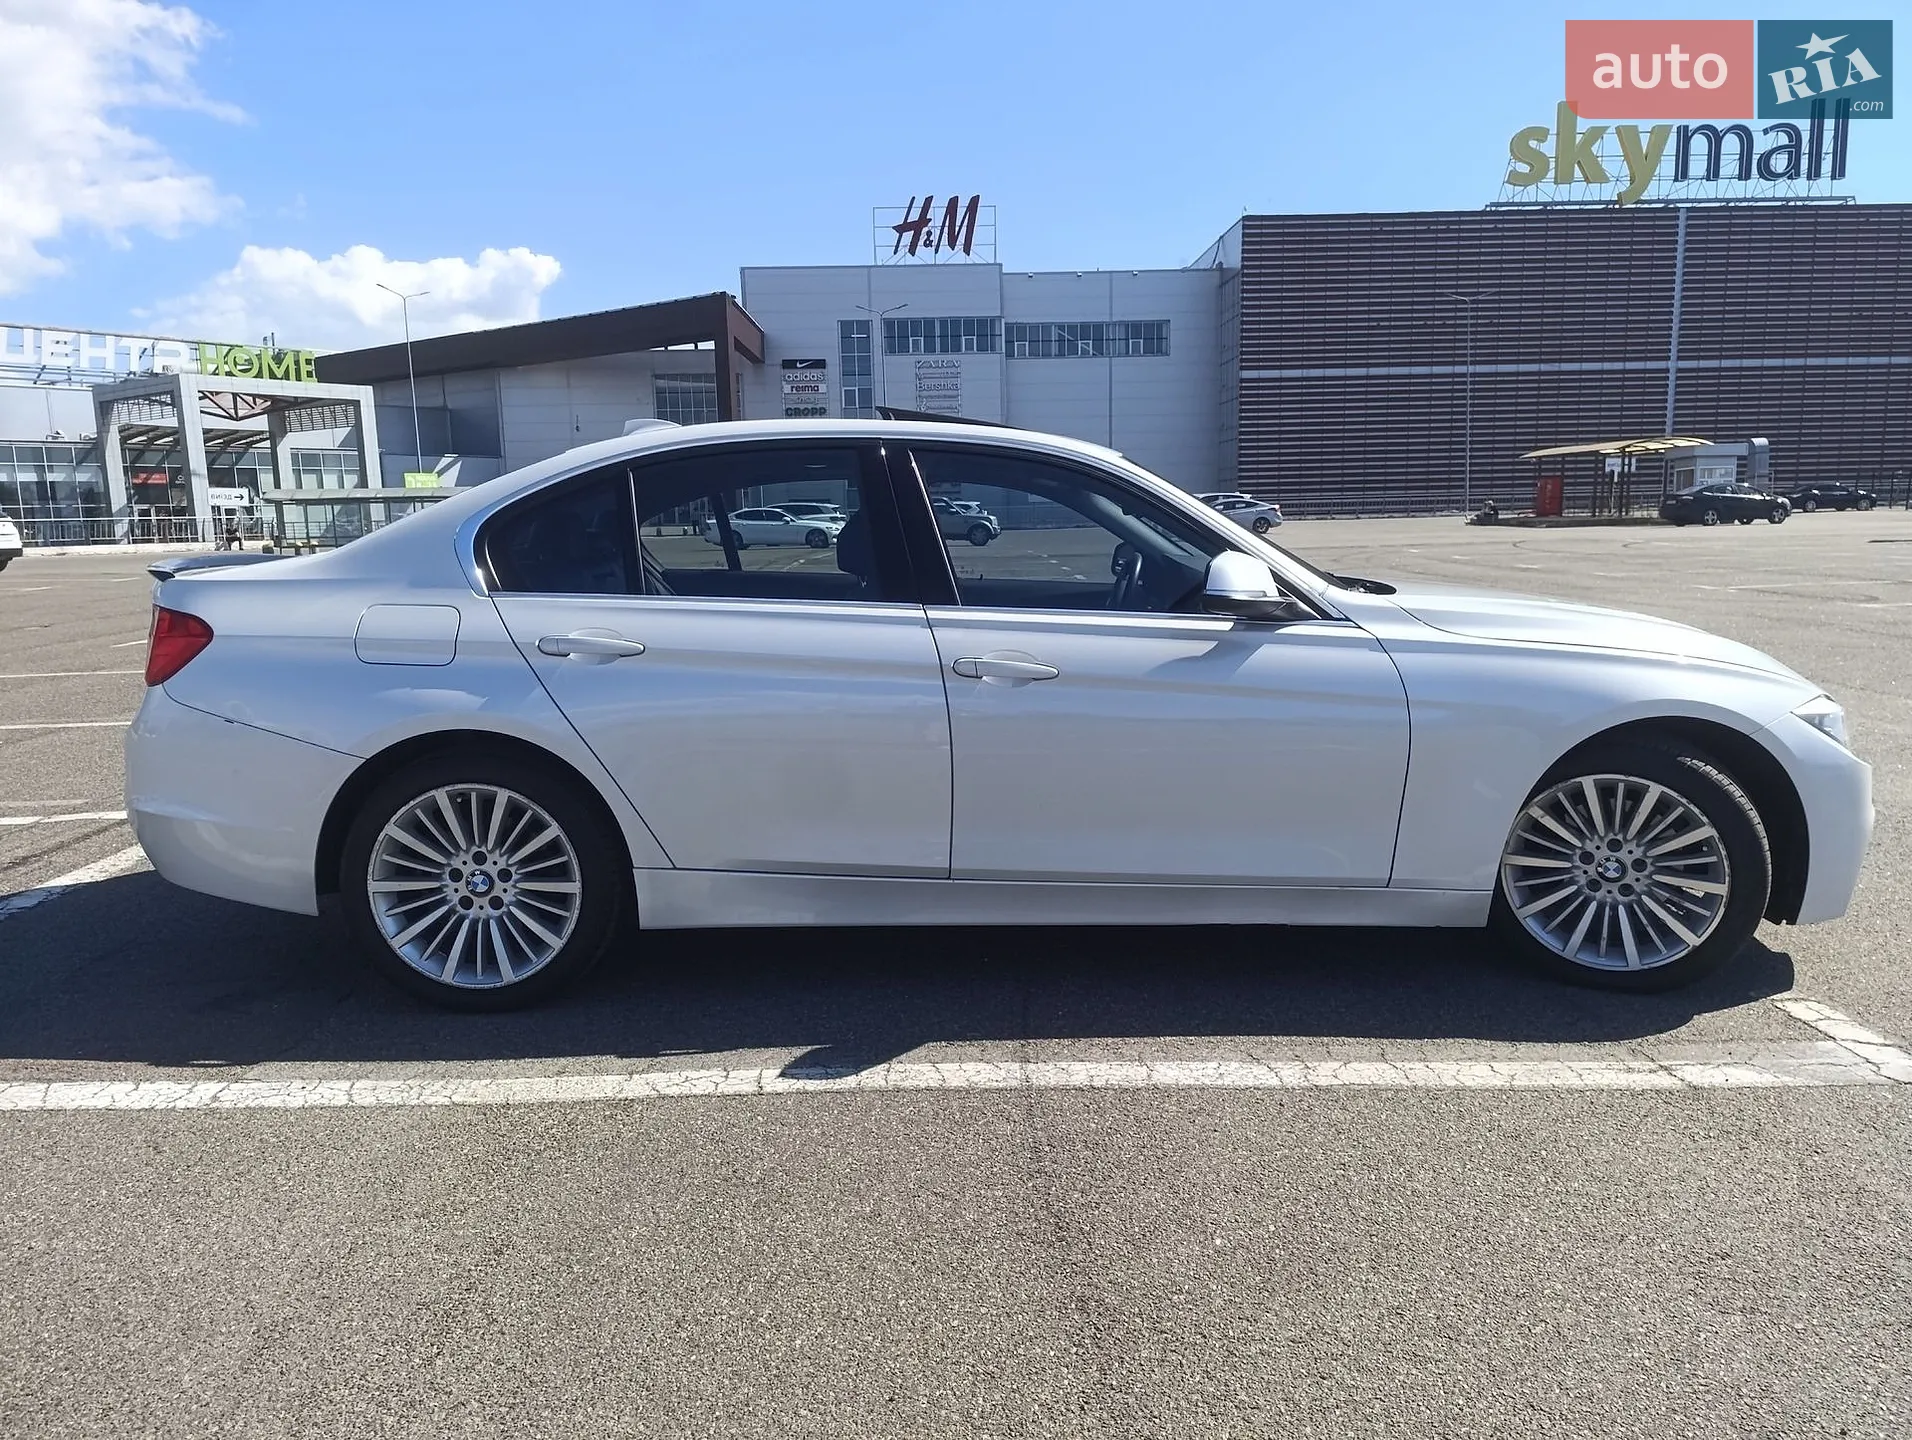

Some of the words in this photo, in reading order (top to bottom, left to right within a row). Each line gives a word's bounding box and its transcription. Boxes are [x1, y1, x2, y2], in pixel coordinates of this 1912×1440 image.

[892, 194, 981, 257] H&M
[198, 342, 318, 382] HOME
[785, 371, 824, 381] adidas
[917, 380, 960, 390] Bershka
[785, 407, 827, 417] CROPP
